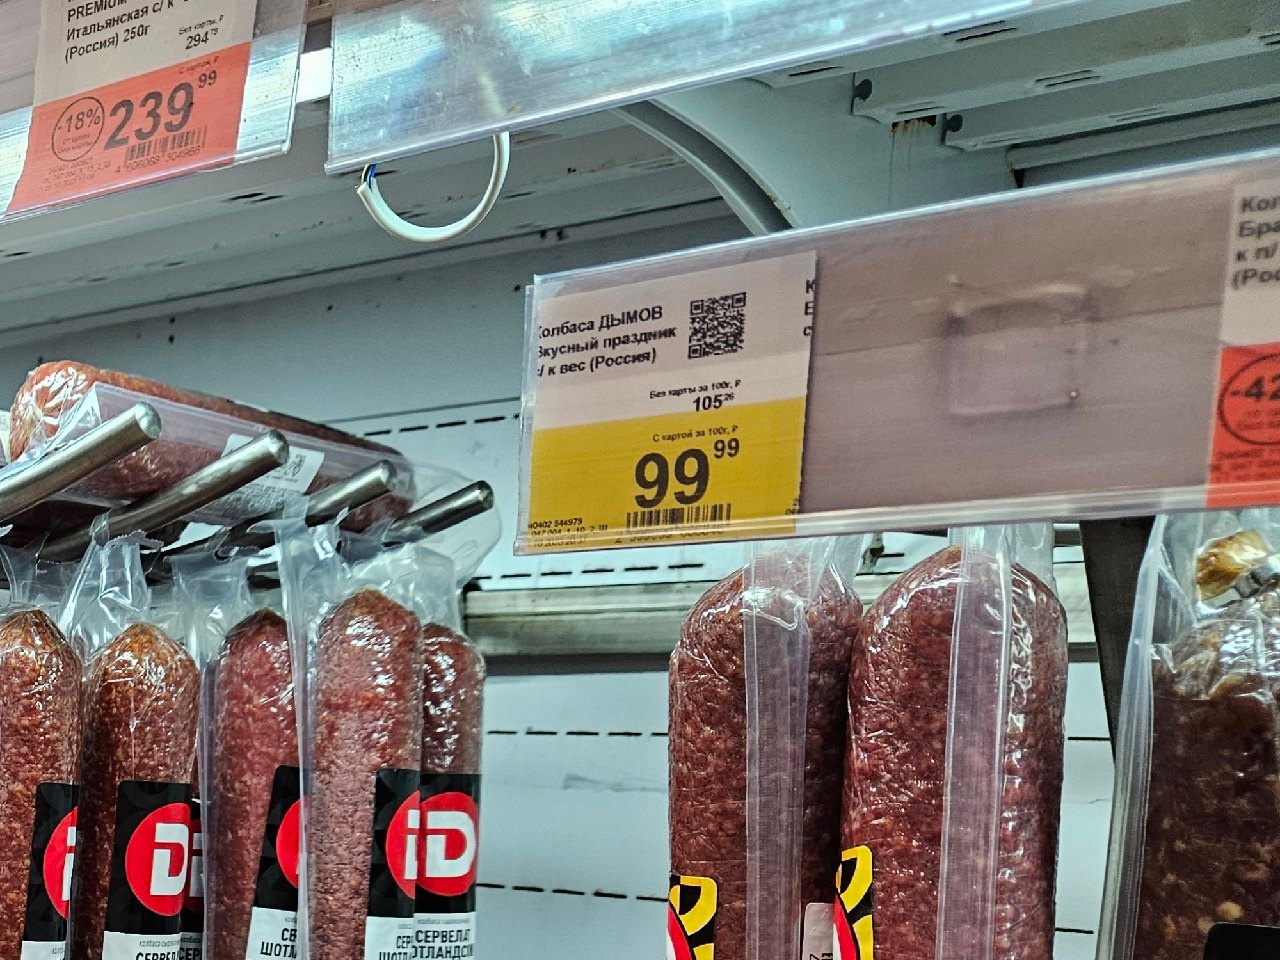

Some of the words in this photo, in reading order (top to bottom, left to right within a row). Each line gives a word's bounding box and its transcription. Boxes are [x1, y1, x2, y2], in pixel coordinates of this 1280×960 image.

[67, 5, 149, 41] Итальянская
[65, 32, 119, 63] (Россия)
[123, 23, 150, 43] 250г
[185, 32, 209, 50] 294
[58, 106, 101, 133] -18%
[104, 82, 195, 150] 239
[198, 71, 217, 88] 99
[598, 305, 663, 330] ДЫМОВ
[603, 327, 677, 349] праздник
[560, 361, 586, 375] вес
[589, 348, 656, 374] (Россия)
[692, 395, 723, 412] 105
[635, 448, 710, 508] 99
[714, 438, 740, 459] 99
